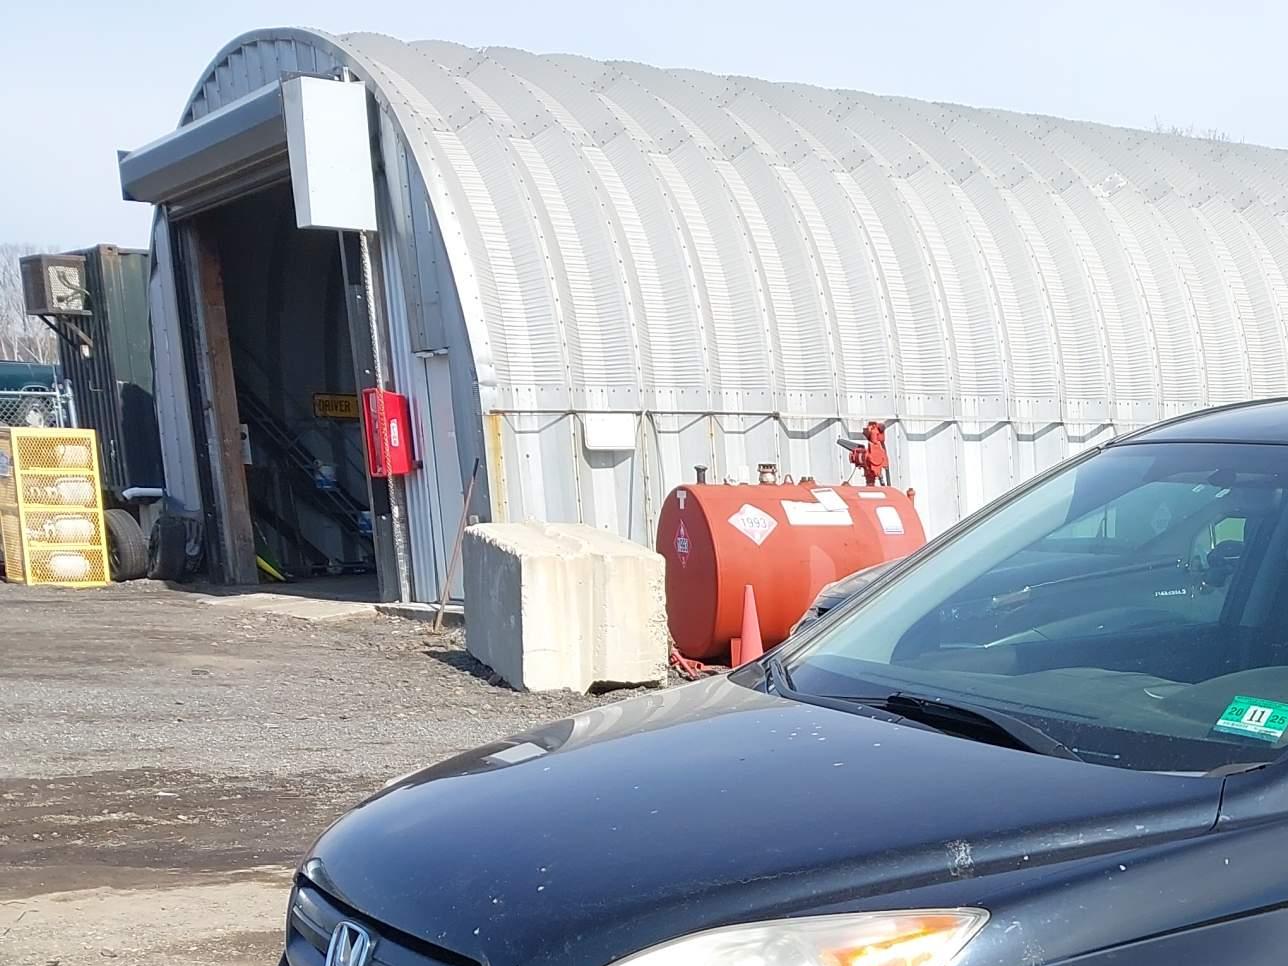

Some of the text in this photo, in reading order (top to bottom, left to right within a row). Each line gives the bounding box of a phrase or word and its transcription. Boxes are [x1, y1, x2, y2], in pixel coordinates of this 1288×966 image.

[318, 400, 351, 413] DRIVER
[741, 517, 767, 529] 1993
[1228, 706, 1244, 717] 20
[1247, 709, 1266, 723] 11
